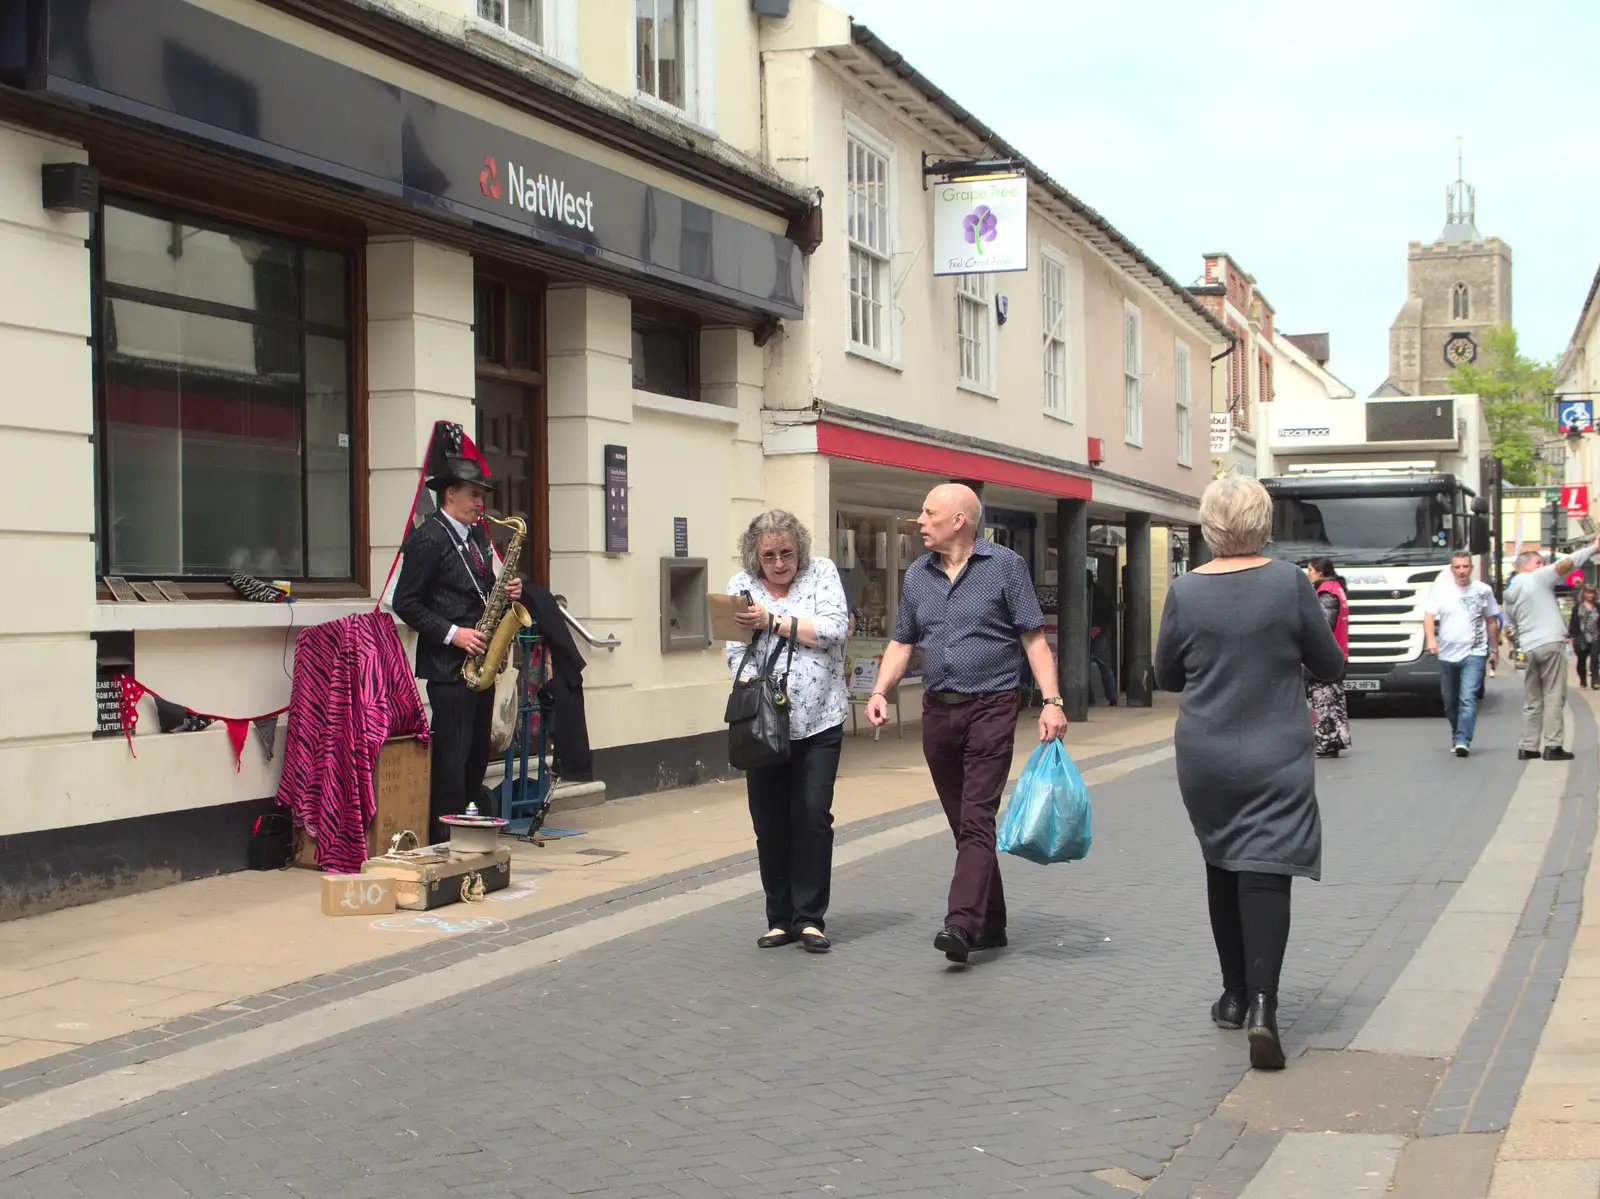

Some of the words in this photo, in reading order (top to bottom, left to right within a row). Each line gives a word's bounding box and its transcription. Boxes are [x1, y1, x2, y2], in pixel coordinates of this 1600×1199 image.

[508, 161, 594, 232] NatWest
[943, 187, 987, 203] Grape
[989, 185, 1018, 198] Tree
[948, 257, 962, 269] Feel
[1211, 416, 1227, 424] bul
[101, 712, 116, 720] VALUE
[103, 722, 121, 730] LETTER
[341, 880, 387, 909] £10
